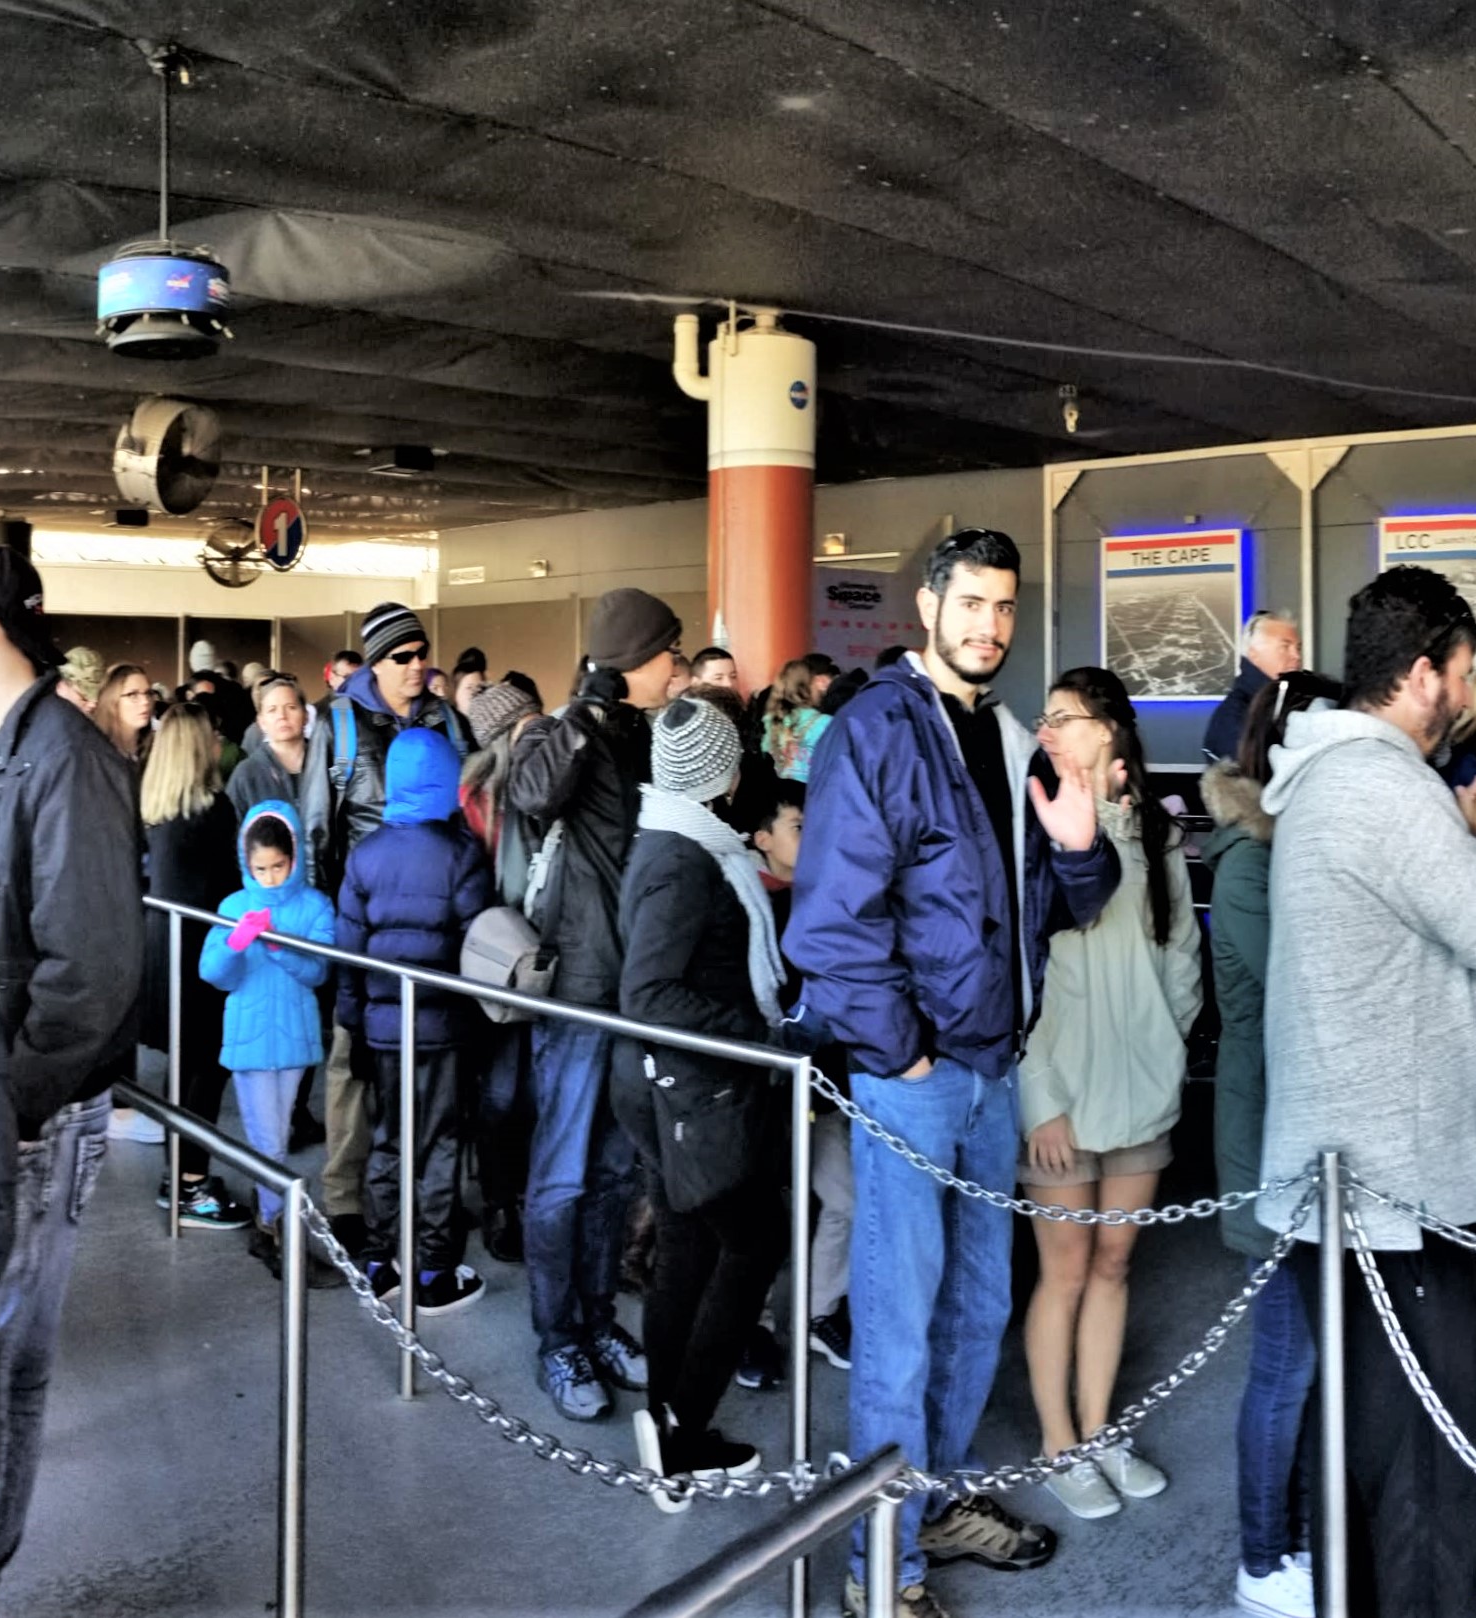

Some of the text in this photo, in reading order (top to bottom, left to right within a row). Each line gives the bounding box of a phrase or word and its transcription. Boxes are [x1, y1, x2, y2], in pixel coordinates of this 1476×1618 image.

[274, 511, 289, 557] 1
[1395, 533, 1431, 550] LCC
[1131, 547, 1211, 566] THE CAPE
